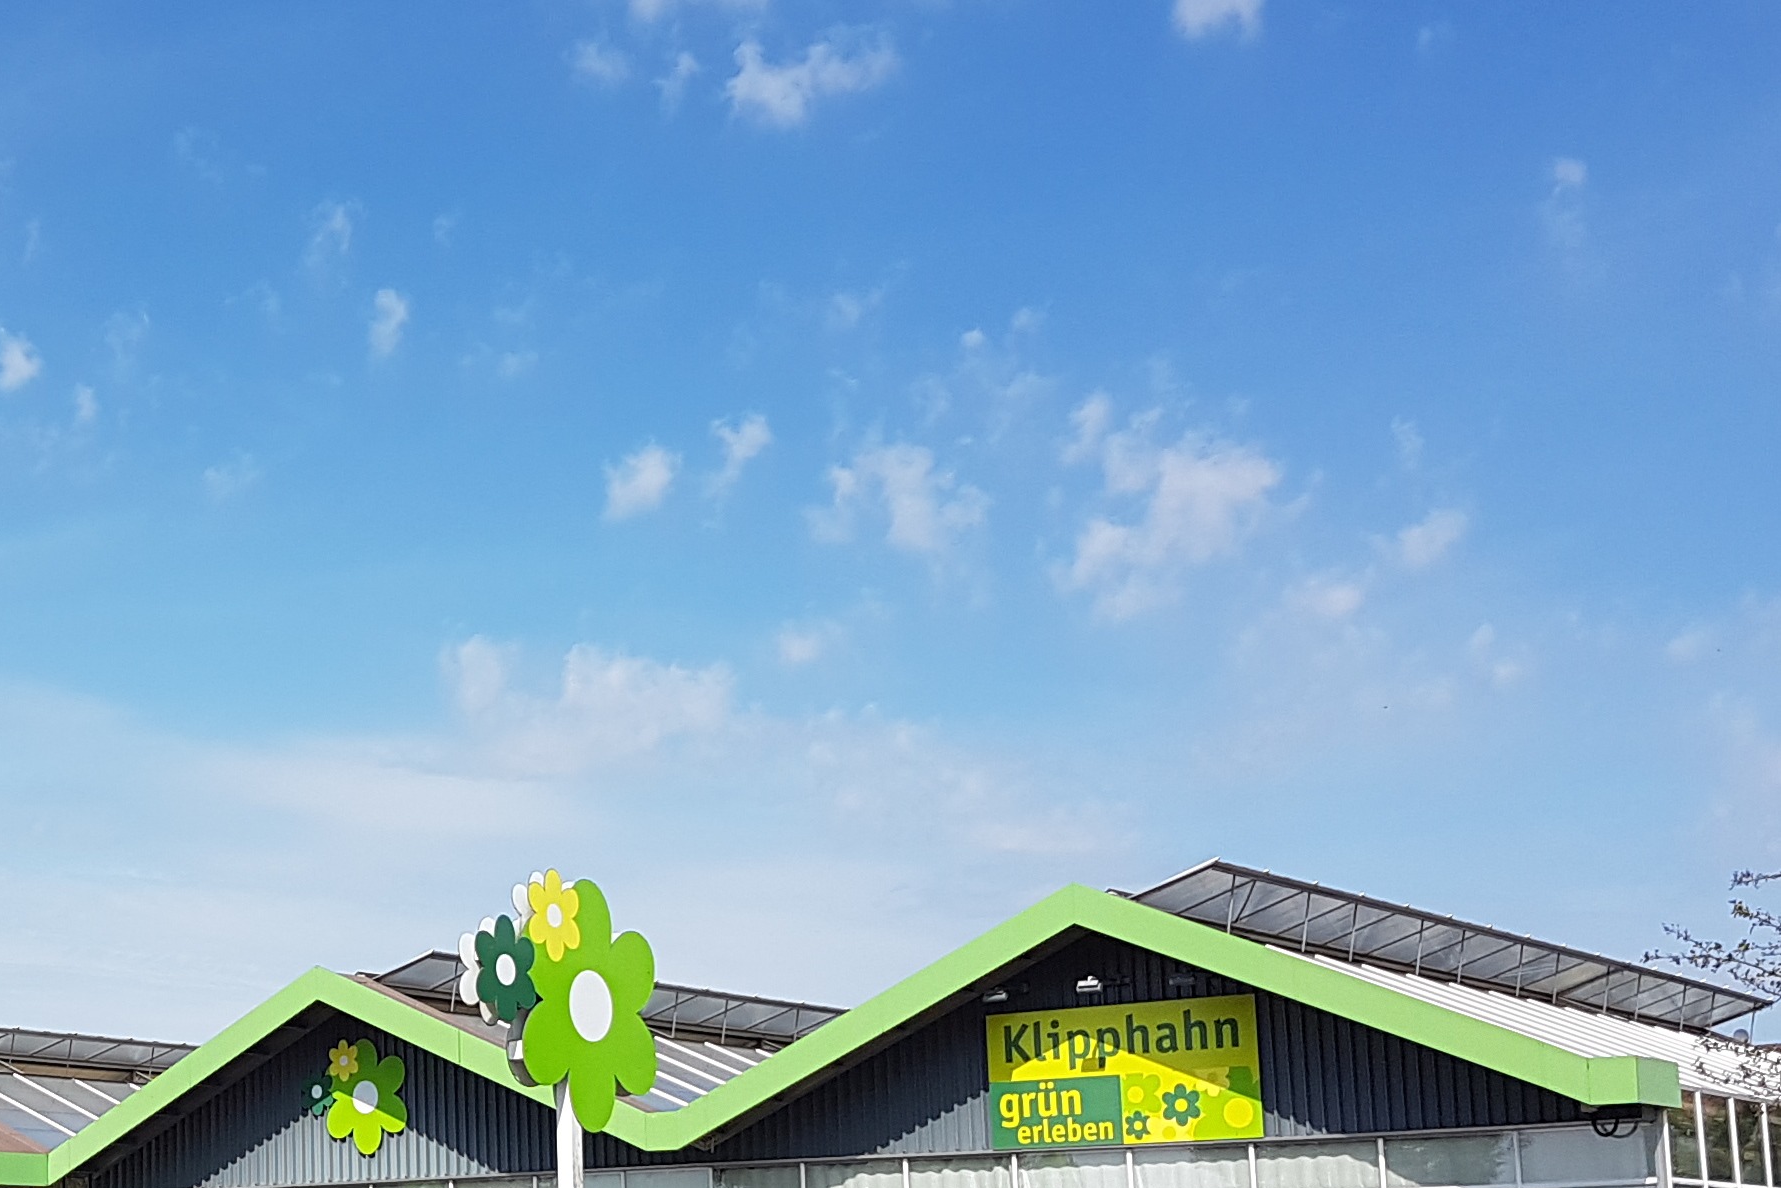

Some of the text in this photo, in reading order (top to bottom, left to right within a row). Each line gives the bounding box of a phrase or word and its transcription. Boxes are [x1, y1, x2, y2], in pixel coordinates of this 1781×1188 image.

[1003, 1009, 1240, 1071] Klipphahn
[999, 1081, 1082, 1128] grün
[1017, 1117, 1114, 1144] erleben
